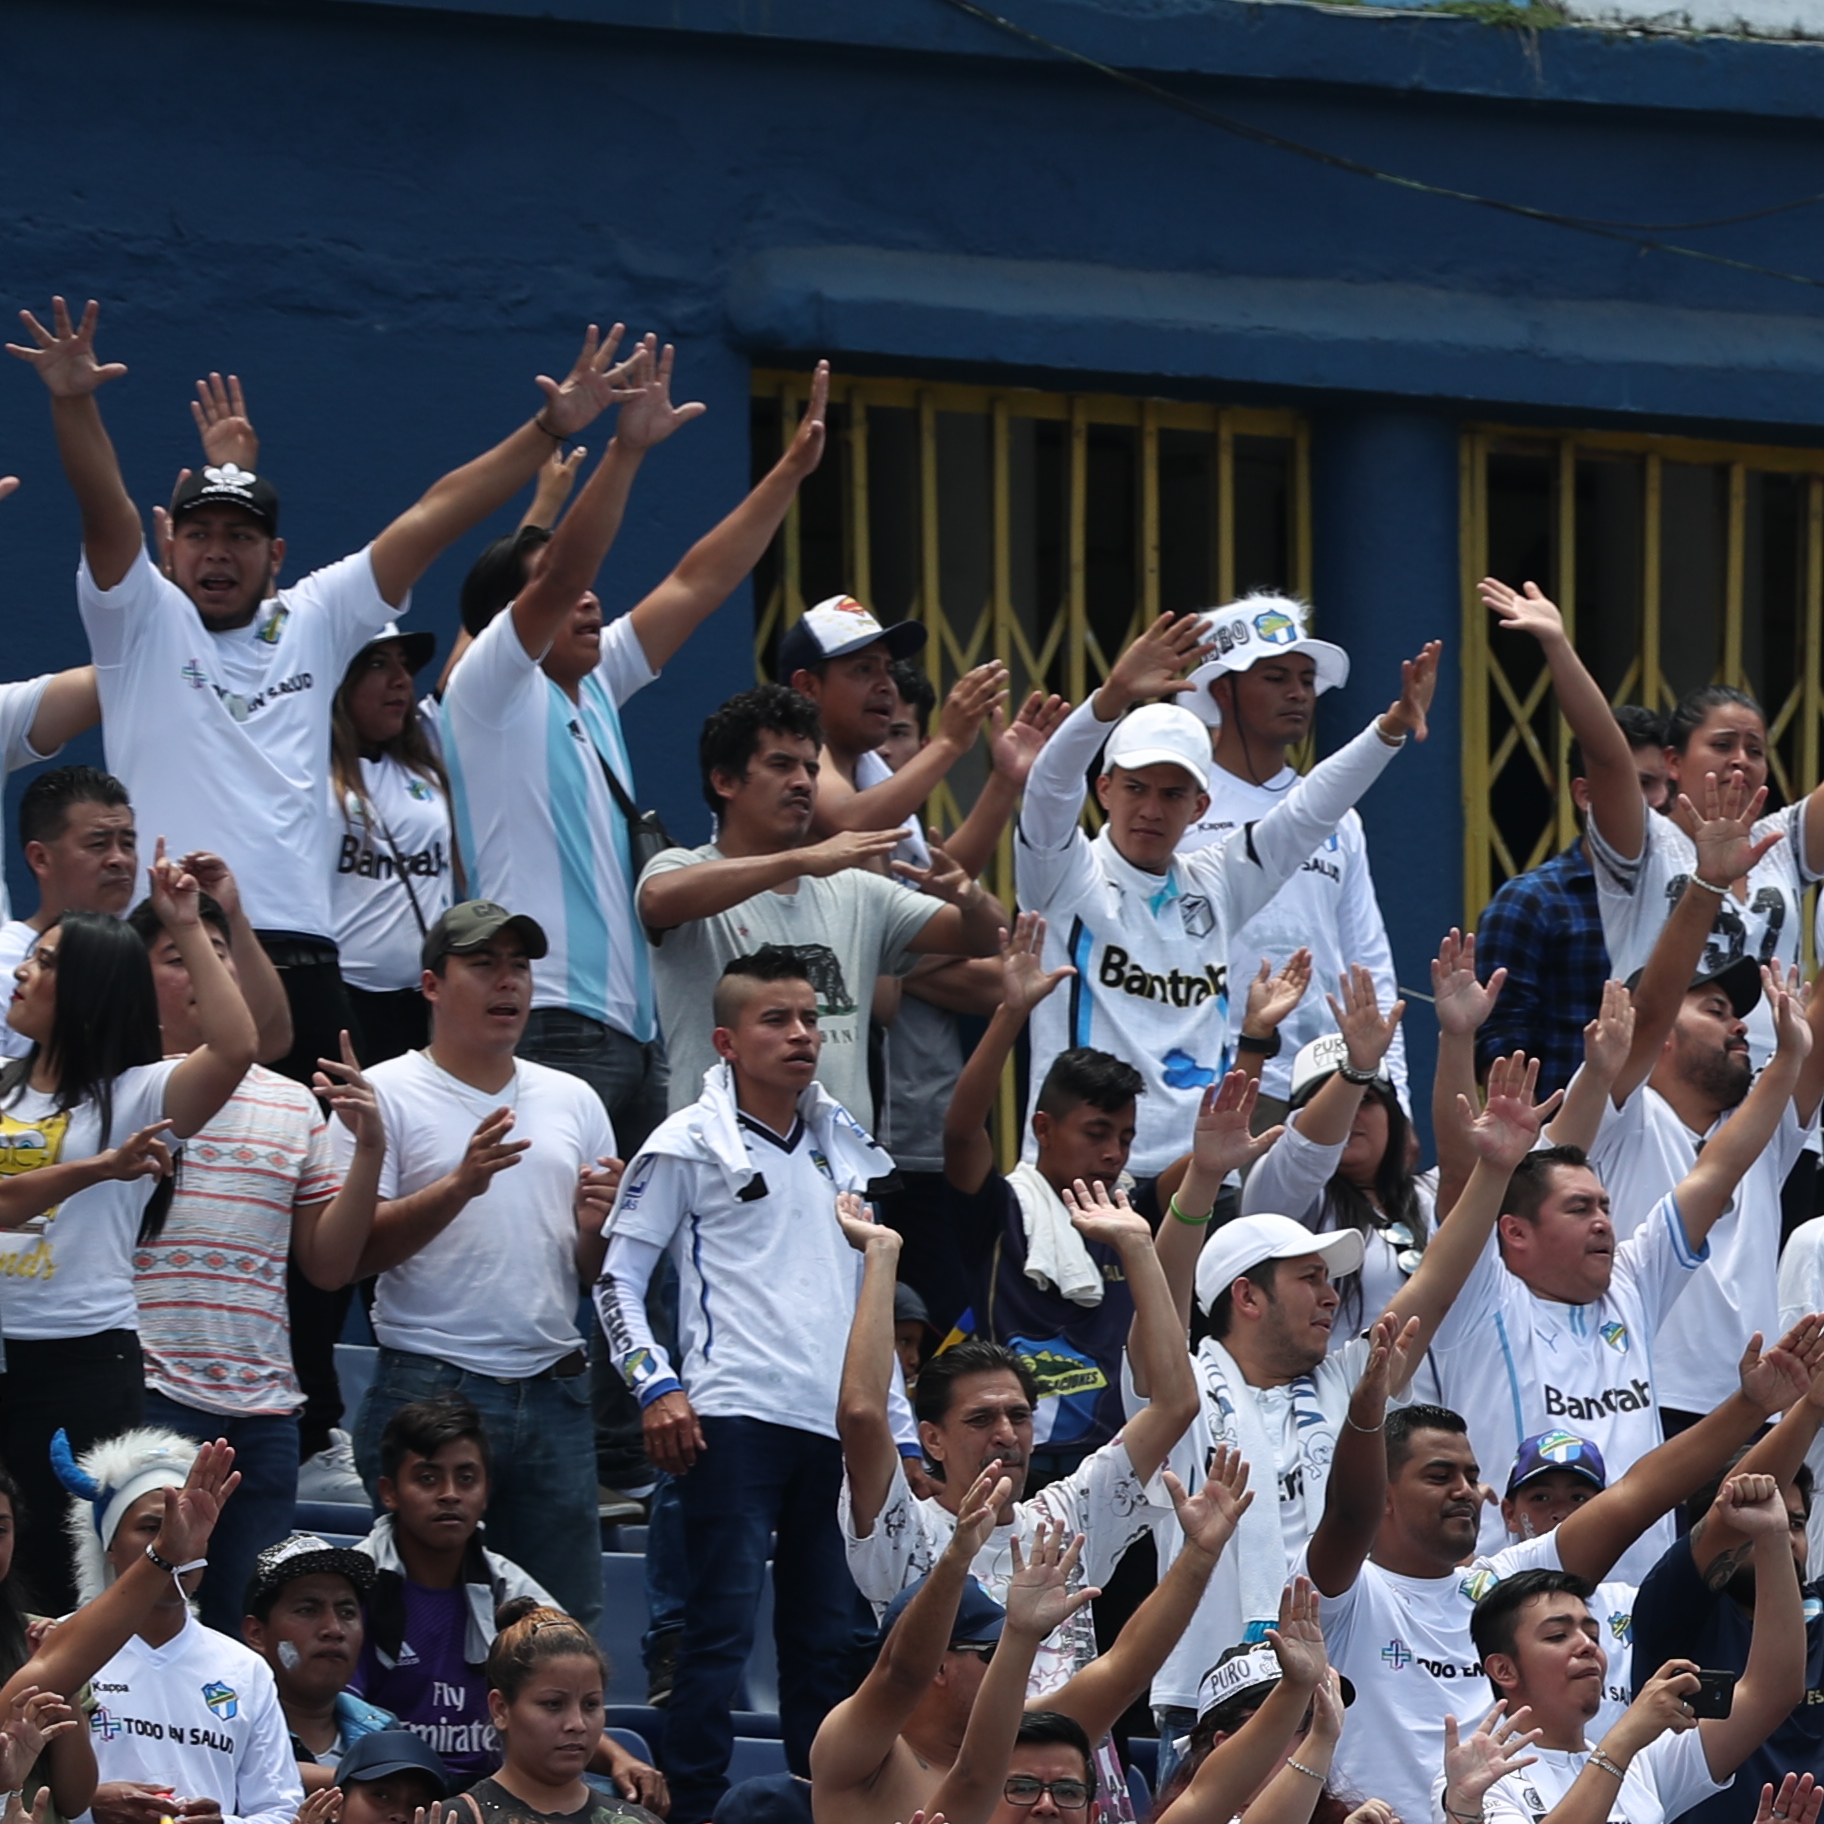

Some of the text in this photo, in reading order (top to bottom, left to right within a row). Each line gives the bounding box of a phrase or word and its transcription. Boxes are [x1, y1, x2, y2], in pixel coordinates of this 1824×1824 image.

[1210, 1658, 1251, 1695] PURO
[433, 1681, 467, 1712] Fly
[124, 1717, 165, 1738] TODO
[192, 1728, 236, 1754] SALUD
[400, 1716, 501, 1753] mirate
